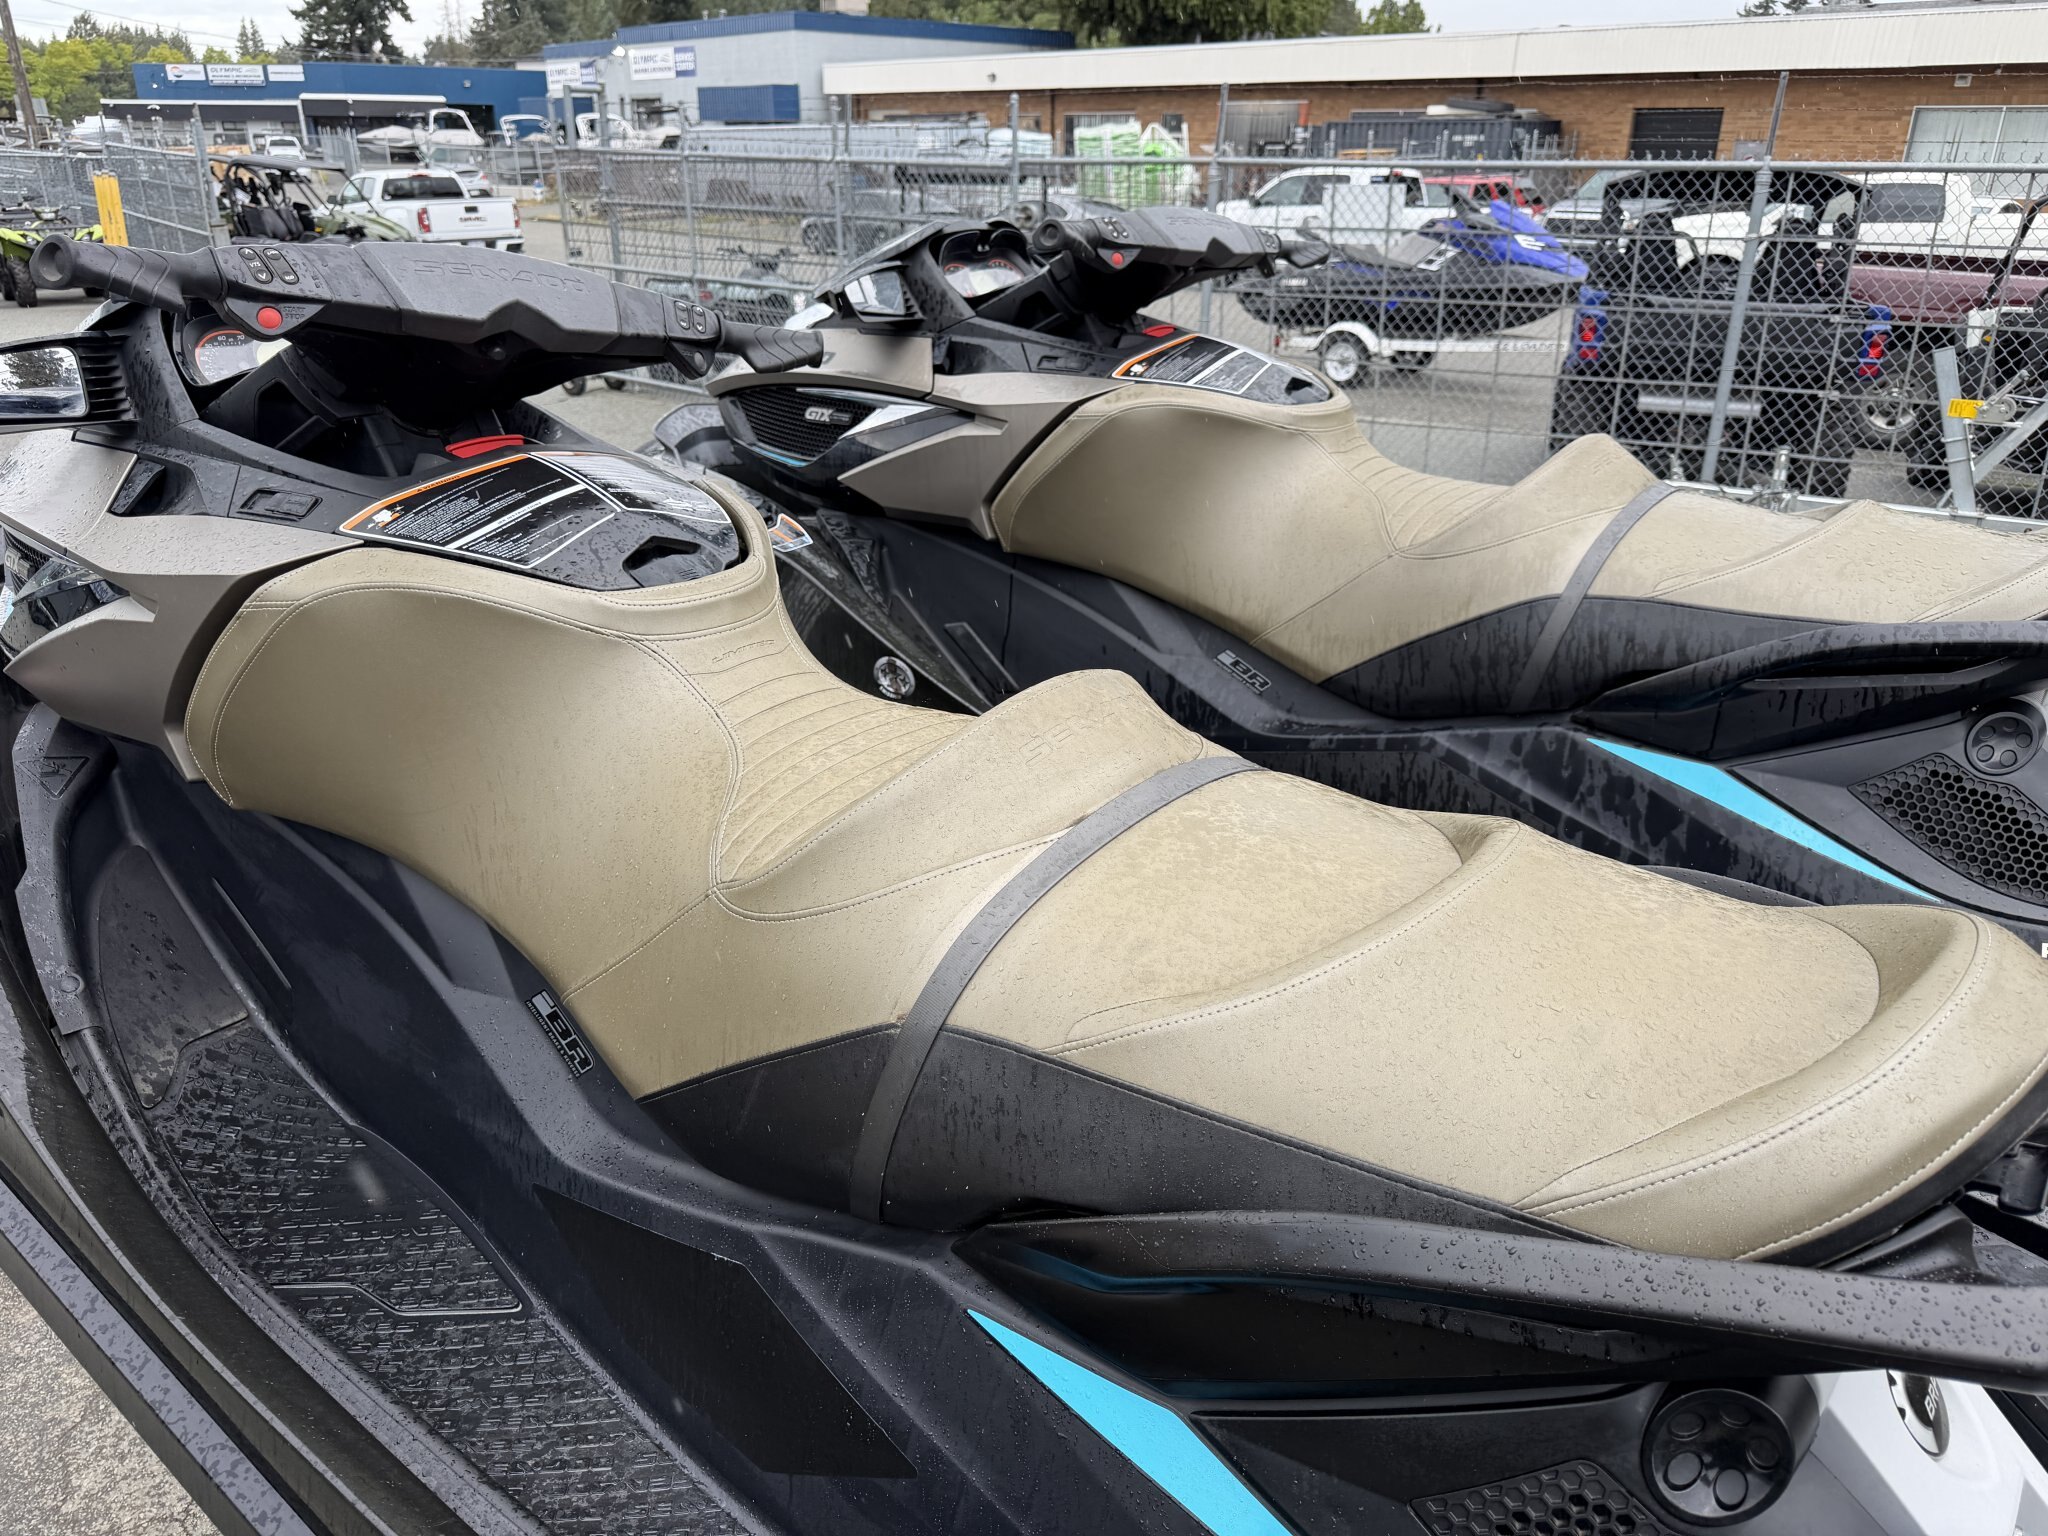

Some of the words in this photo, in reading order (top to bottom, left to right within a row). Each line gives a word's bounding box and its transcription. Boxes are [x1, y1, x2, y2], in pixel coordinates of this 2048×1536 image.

[804, 406, 834, 422] GTX
[5, 549, 20, 573] GTX
[525, 1000, 550, 1033] INTELLIGENT
[547, 1032, 562, 1050] BRAKE
[563, 1054, 581, 1078] REVERSE
